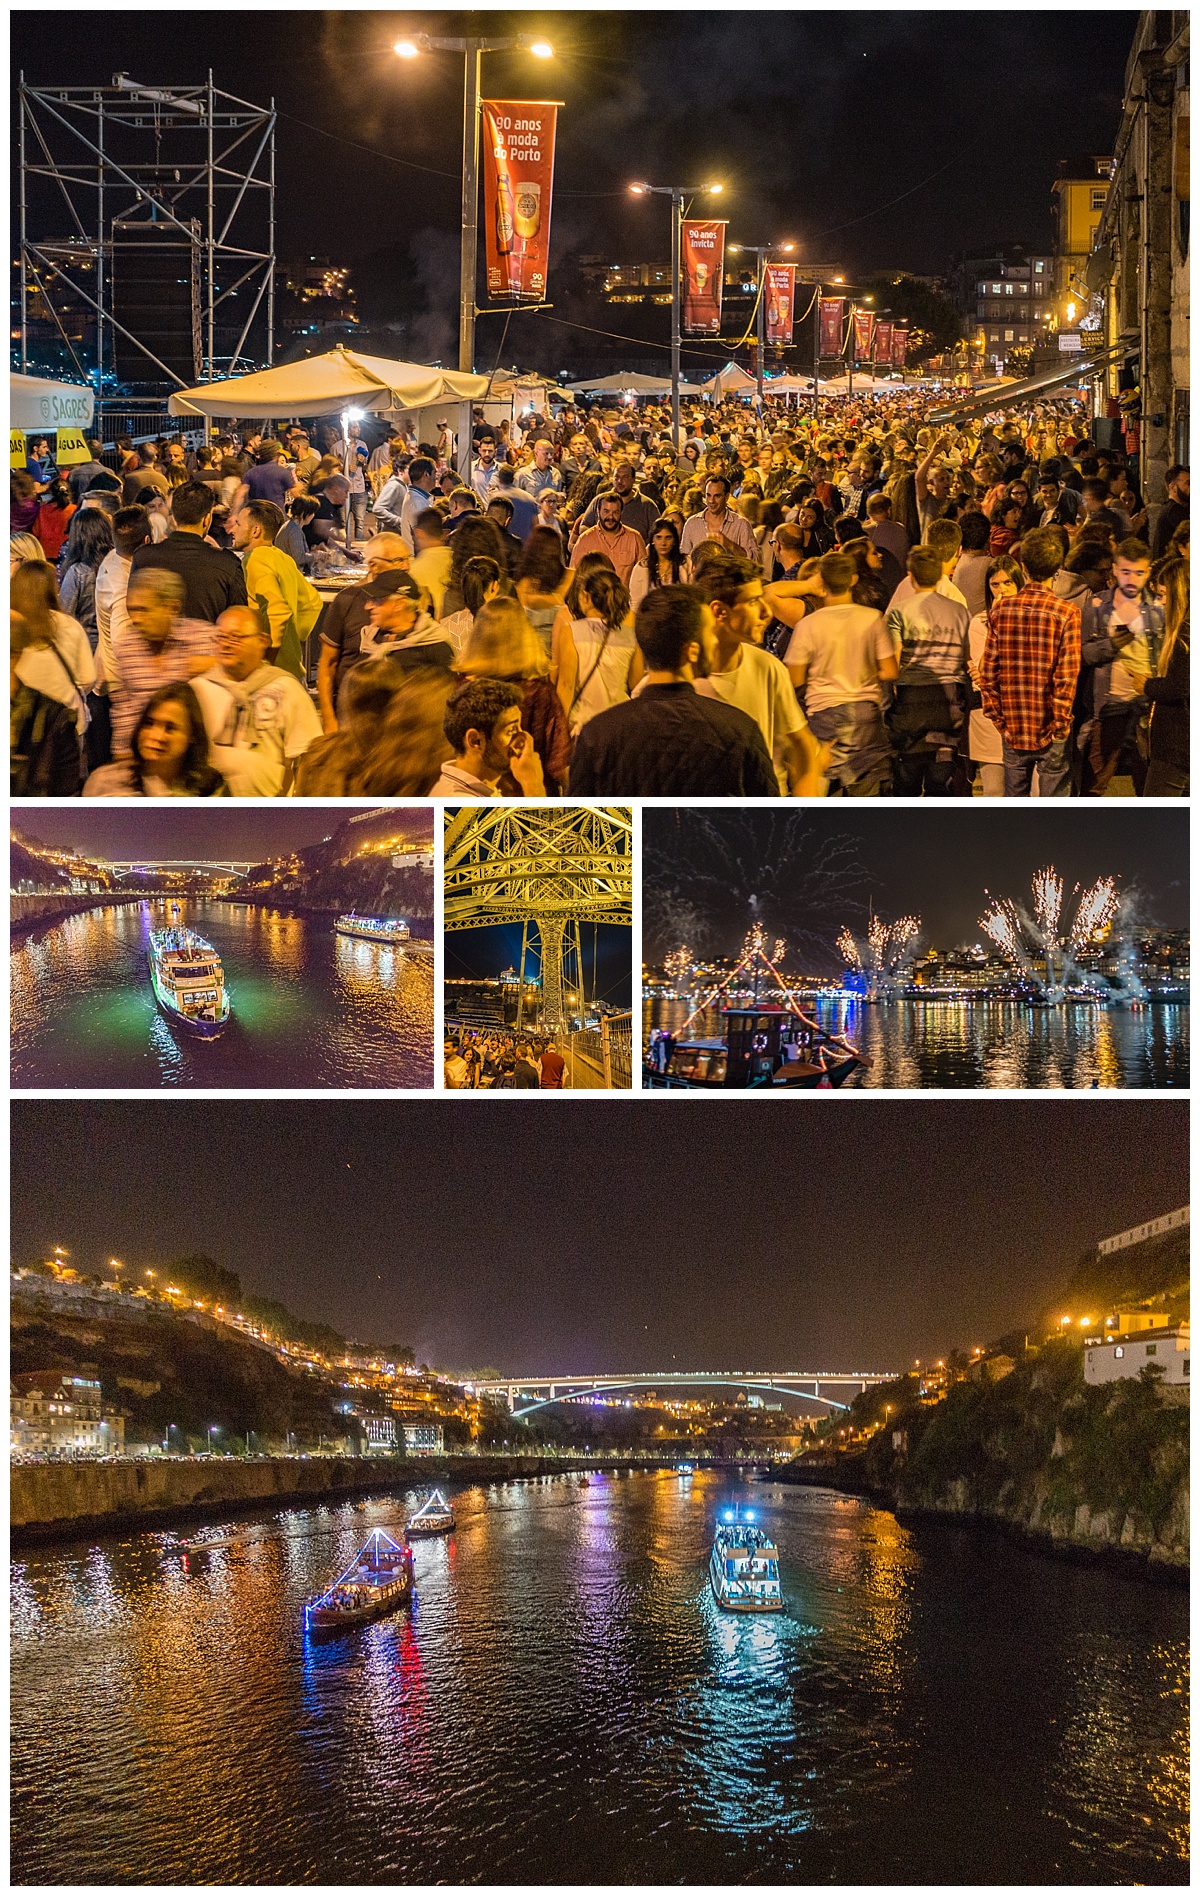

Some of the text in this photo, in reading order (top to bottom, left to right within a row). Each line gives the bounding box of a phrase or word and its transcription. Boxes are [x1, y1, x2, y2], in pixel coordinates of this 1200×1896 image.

[496, 117, 542, 131] 90 anos
[496, 132, 539, 146] à moda
[493, 146, 541, 161] do Porto
[689, 230, 717, 239] 90 anos
[691, 240, 715, 248] invicta
[52, 395, 91, 421] SAGRES
[57, 437, 86, 450] ÁGUA
